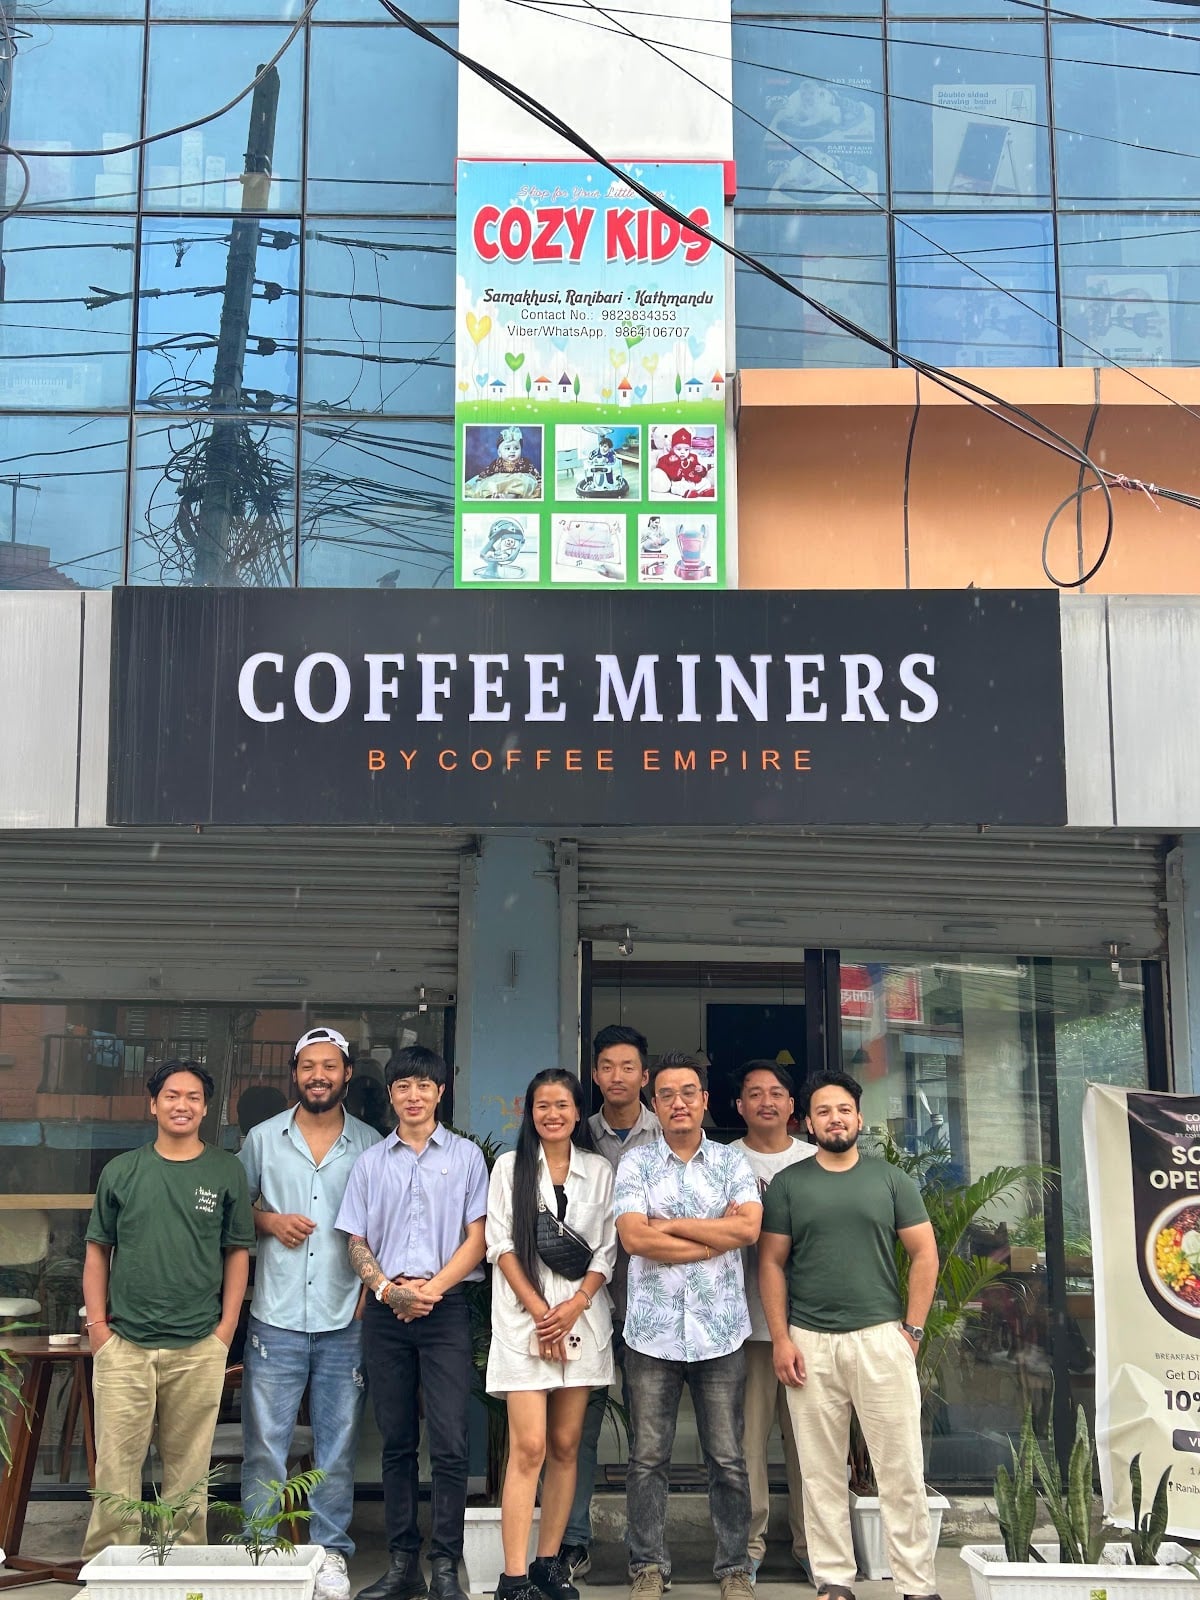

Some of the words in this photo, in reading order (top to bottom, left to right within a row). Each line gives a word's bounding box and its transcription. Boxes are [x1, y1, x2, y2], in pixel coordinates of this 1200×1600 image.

[939, 98, 969, 106] drawing
[517, 185, 550, 200] Shop
[551, 186, 568, 201] for
[573, 186, 601, 200] Your
[605, 186, 635, 199] Little
[473, 205, 596, 263] COZY
[606, 206, 713, 264] KIDS
[483, 289, 562, 306] Samakhusi,
[565, 290, 624, 306] Ranibari
[635, 290, 714, 307] Kathmandu
[521, 309, 565, 320] Contact
[601, 310, 676, 321] 9823834353
[615, 326, 690, 337] 9864106707
[238, 651, 567, 723] COFFEE
[593, 652, 939, 723] MINERS
[368, 749, 418, 771] BY
[438, 749, 614, 771] COFFEE
[643, 749, 812, 771] EMPIRE
[1149, 1169, 1200, 1190] OPE
[1155, 1352, 1200, 1361] BREAKFAST
[1166, 1369, 1185, 1380] Get
